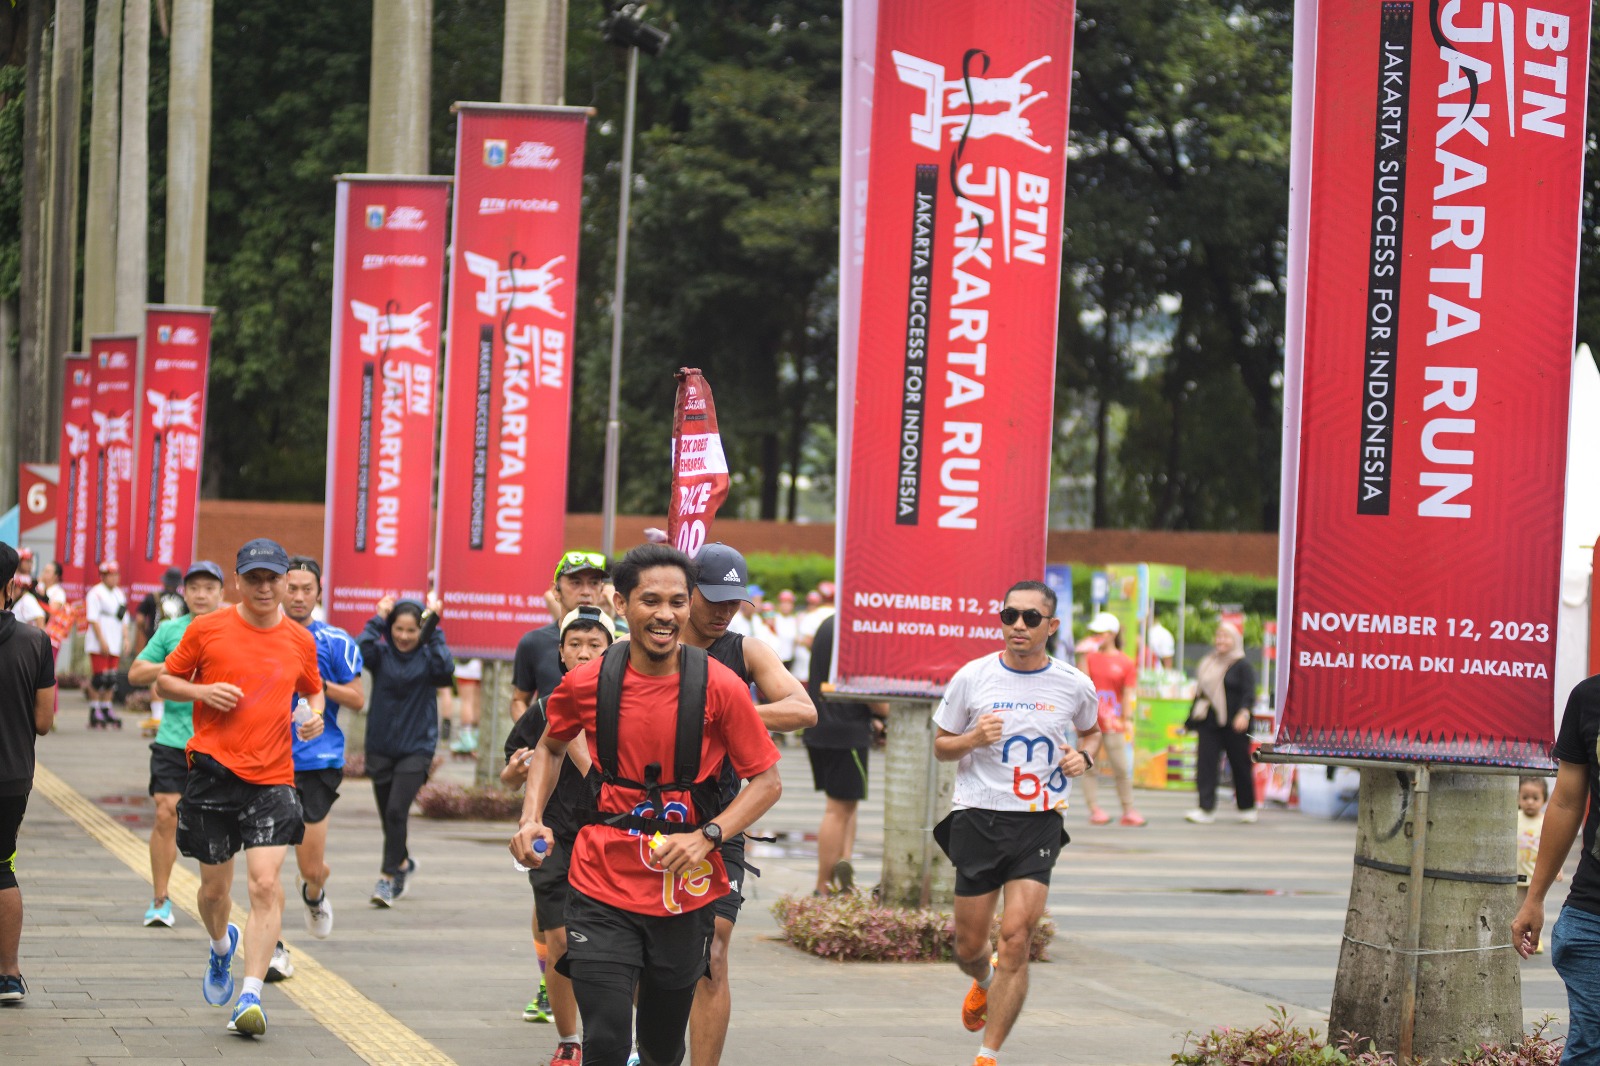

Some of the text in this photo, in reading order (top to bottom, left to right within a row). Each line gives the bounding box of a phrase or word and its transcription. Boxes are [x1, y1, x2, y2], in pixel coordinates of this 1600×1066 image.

[1522, 7, 1570, 138] BTN
[1013, 171, 1050, 265] BTN
[1363, 41, 1404, 501] JAKARTA SUCCESS FOR INDONESIA
[1417, 0, 1494, 519] JAKARTA RUN
[541, 327, 565, 389] BTN
[898, 191, 932, 517] JAKARTA SUCCESS FOR INDONESIA
[937, 163, 996, 530] JAKARTA RUN
[411, 363, 432, 416] BTN
[475, 392, 489, 448] SUCCESS
[495, 322, 531, 555] JAKARTA RUN
[374, 359, 404, 556] JAKARTA RUN
[474, 450, 486, 475] FOR
[27, 483, 47, 515] 6
[470, 478, 485, 547] INDONESIA
[679, 482, 712, 517] PACE
[723, 575, 740, 583] adidas
[854, 592, 952, 611] NOVEMBER
[958, 598, 983, 615] 12,
[852, 619, 894, 634] BALAI
[897, 622, 936, 636] KOTA
[938, 624, 965, 638] DKI
[1301, 611, 1550, 643] NOVEMBER 12, 2023
[1299, 651, 1548, 680] BALAI KOTA DKI JAKARTA
[1015, 702, 1055, 712] mobile
